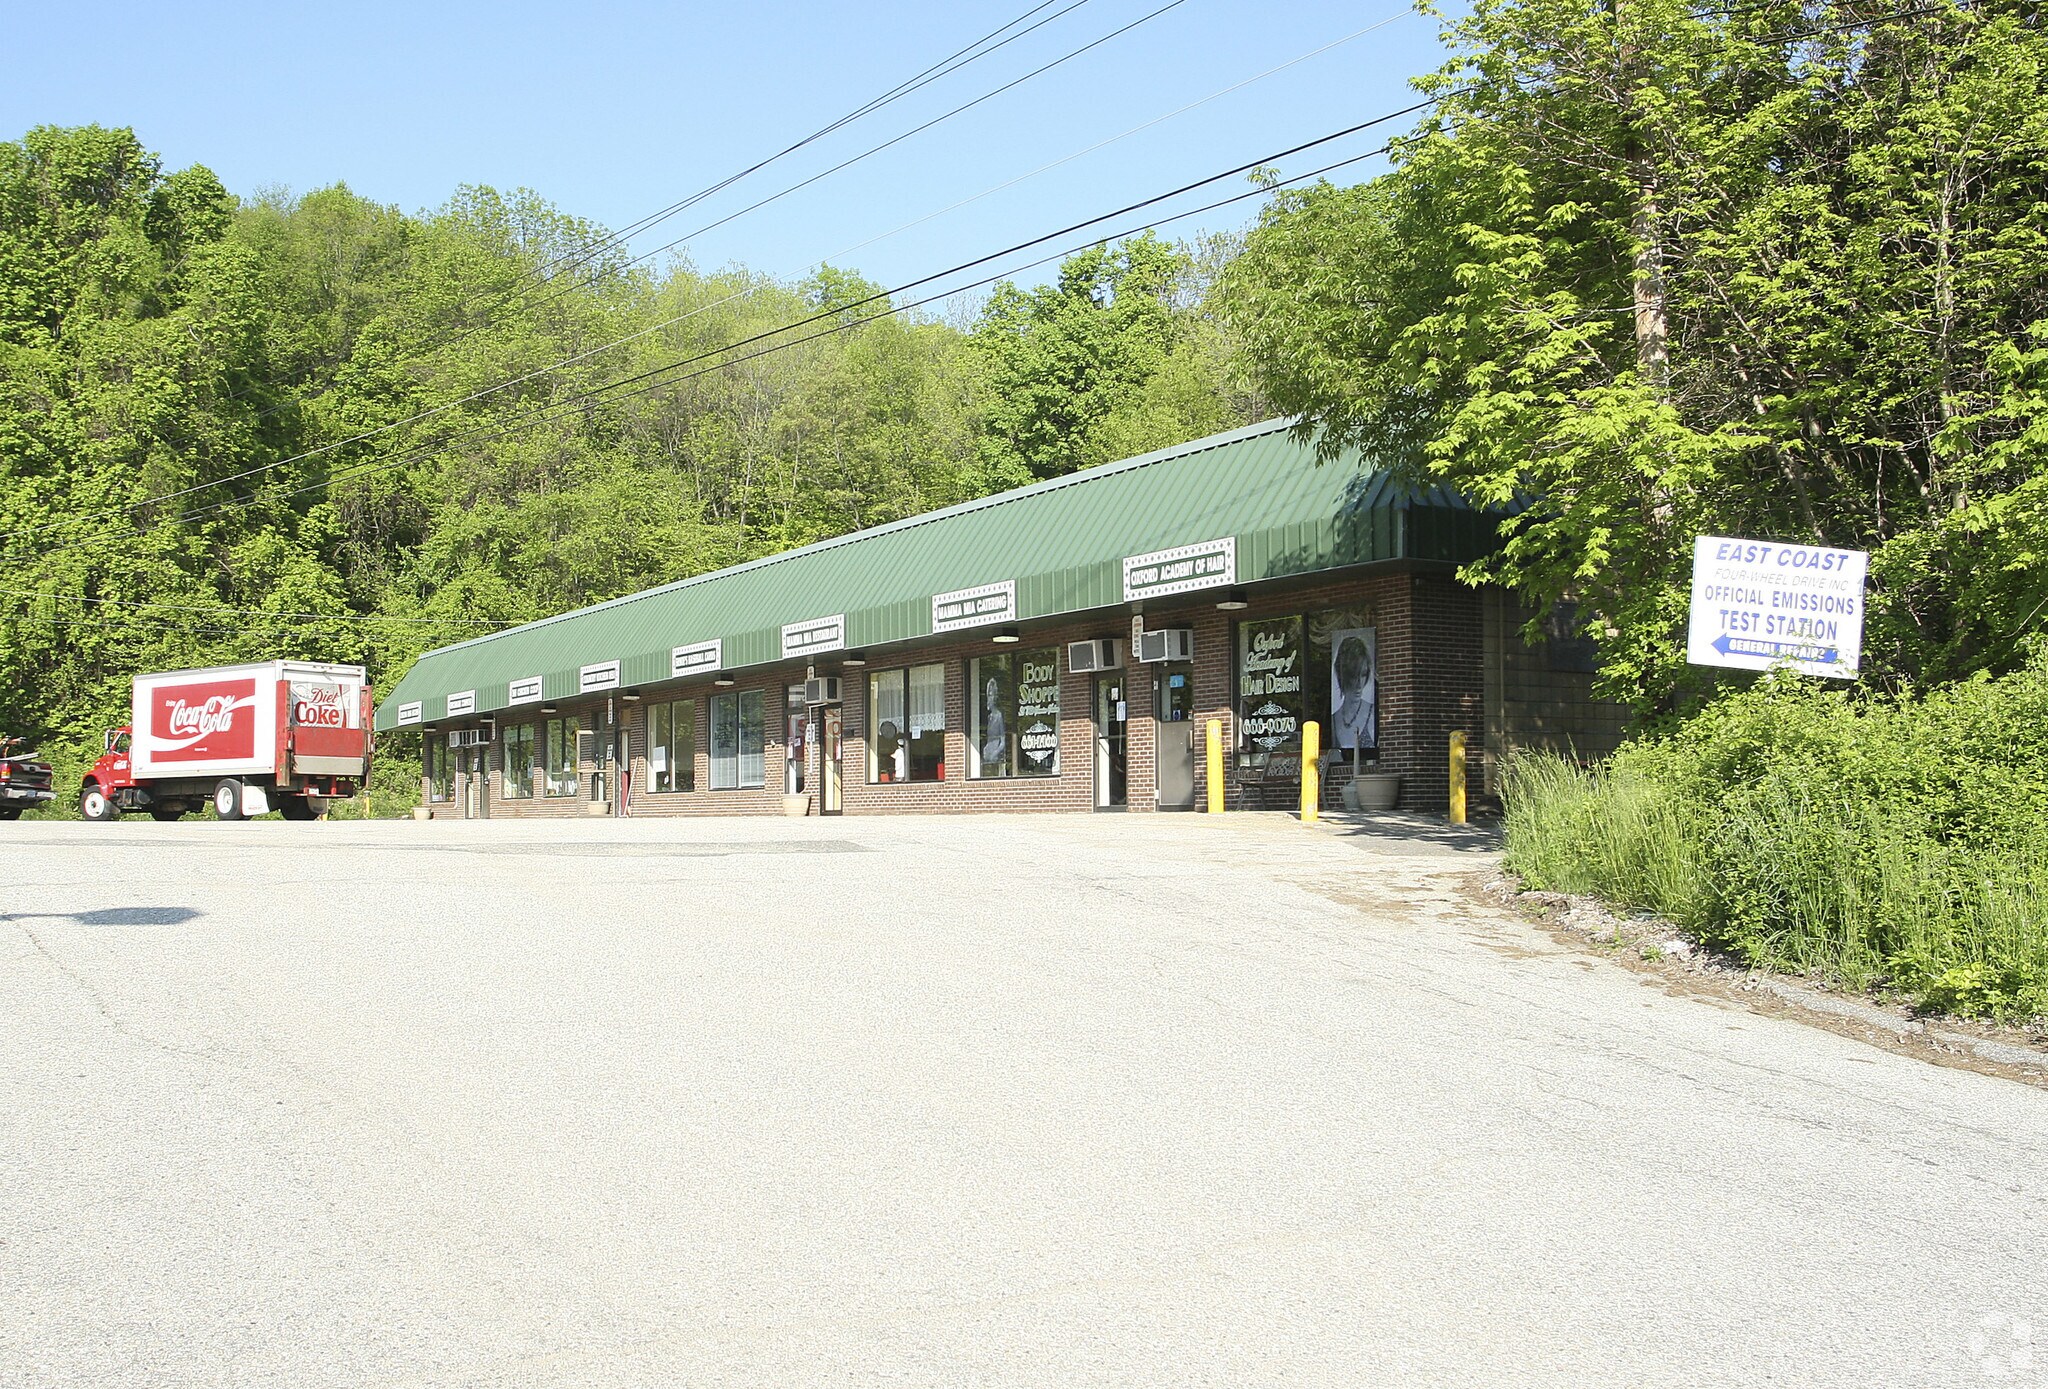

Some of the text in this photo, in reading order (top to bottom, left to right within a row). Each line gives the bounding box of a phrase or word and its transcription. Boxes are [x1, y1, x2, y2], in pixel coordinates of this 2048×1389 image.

[1131, 554, 1225, 586] OXFORD ACADEMY OF HAIR
[1715, 543, 1849, 572] EAST COAST
[1714, 568, 1849, 592] FOUR-WHEEL DRIVE INC
[938, 595, 1007, 620] MAMMA MIA CATERING
[1705, 585, 1854, 616] OFFICIAL EMISSIONS
[1719, 609, 1838, 640] TEST STATION
[1728, 639, 1775, 654] GENERAL
[311, 687, 339, 704] Diet
[169, 695, 236, 735] Coca-Cola
[295, 701, 340, 726] Coke
